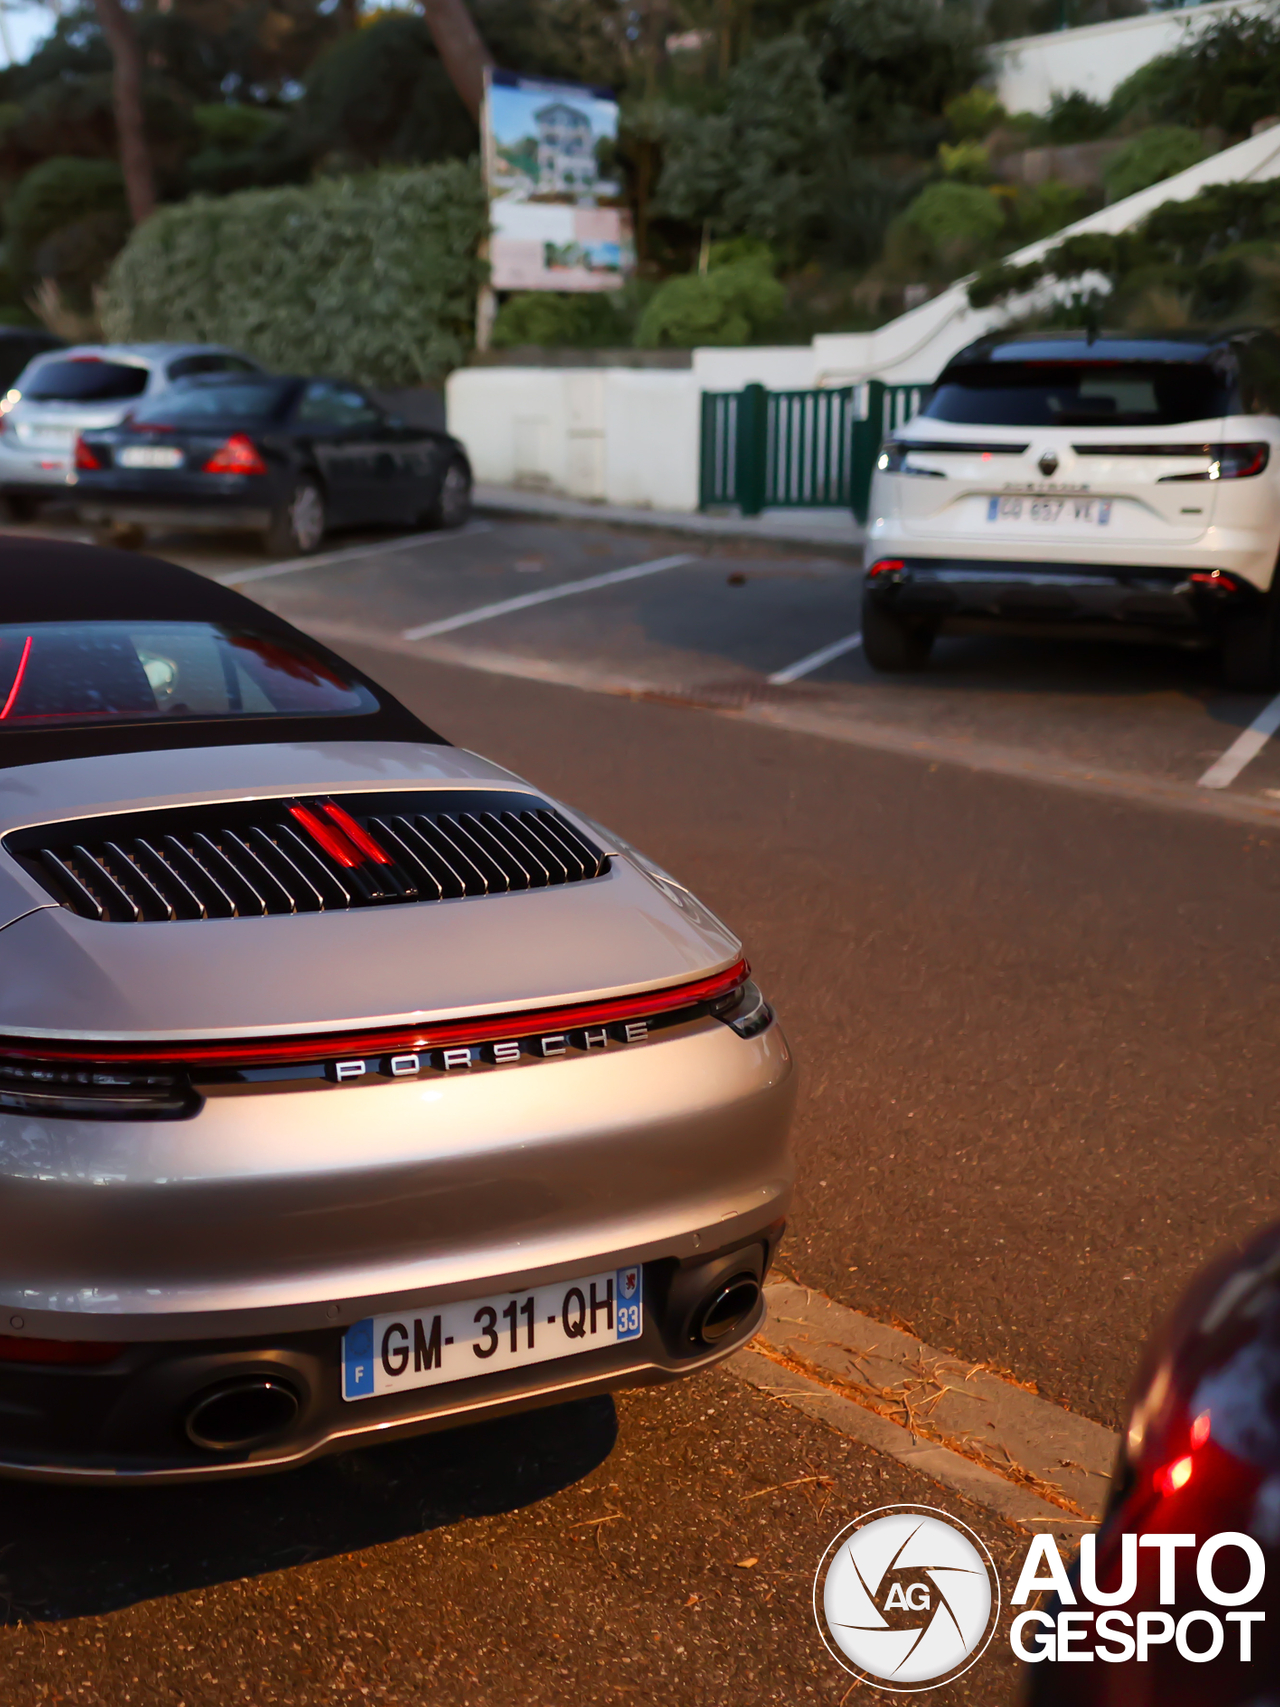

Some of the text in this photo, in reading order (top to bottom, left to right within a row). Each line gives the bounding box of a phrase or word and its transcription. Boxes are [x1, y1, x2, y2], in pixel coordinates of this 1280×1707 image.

[335, 1022, 649, 1082] PORSCHE
[354, 1366, 365, 1383] F
[618, 1305, 639, 1333] 33
